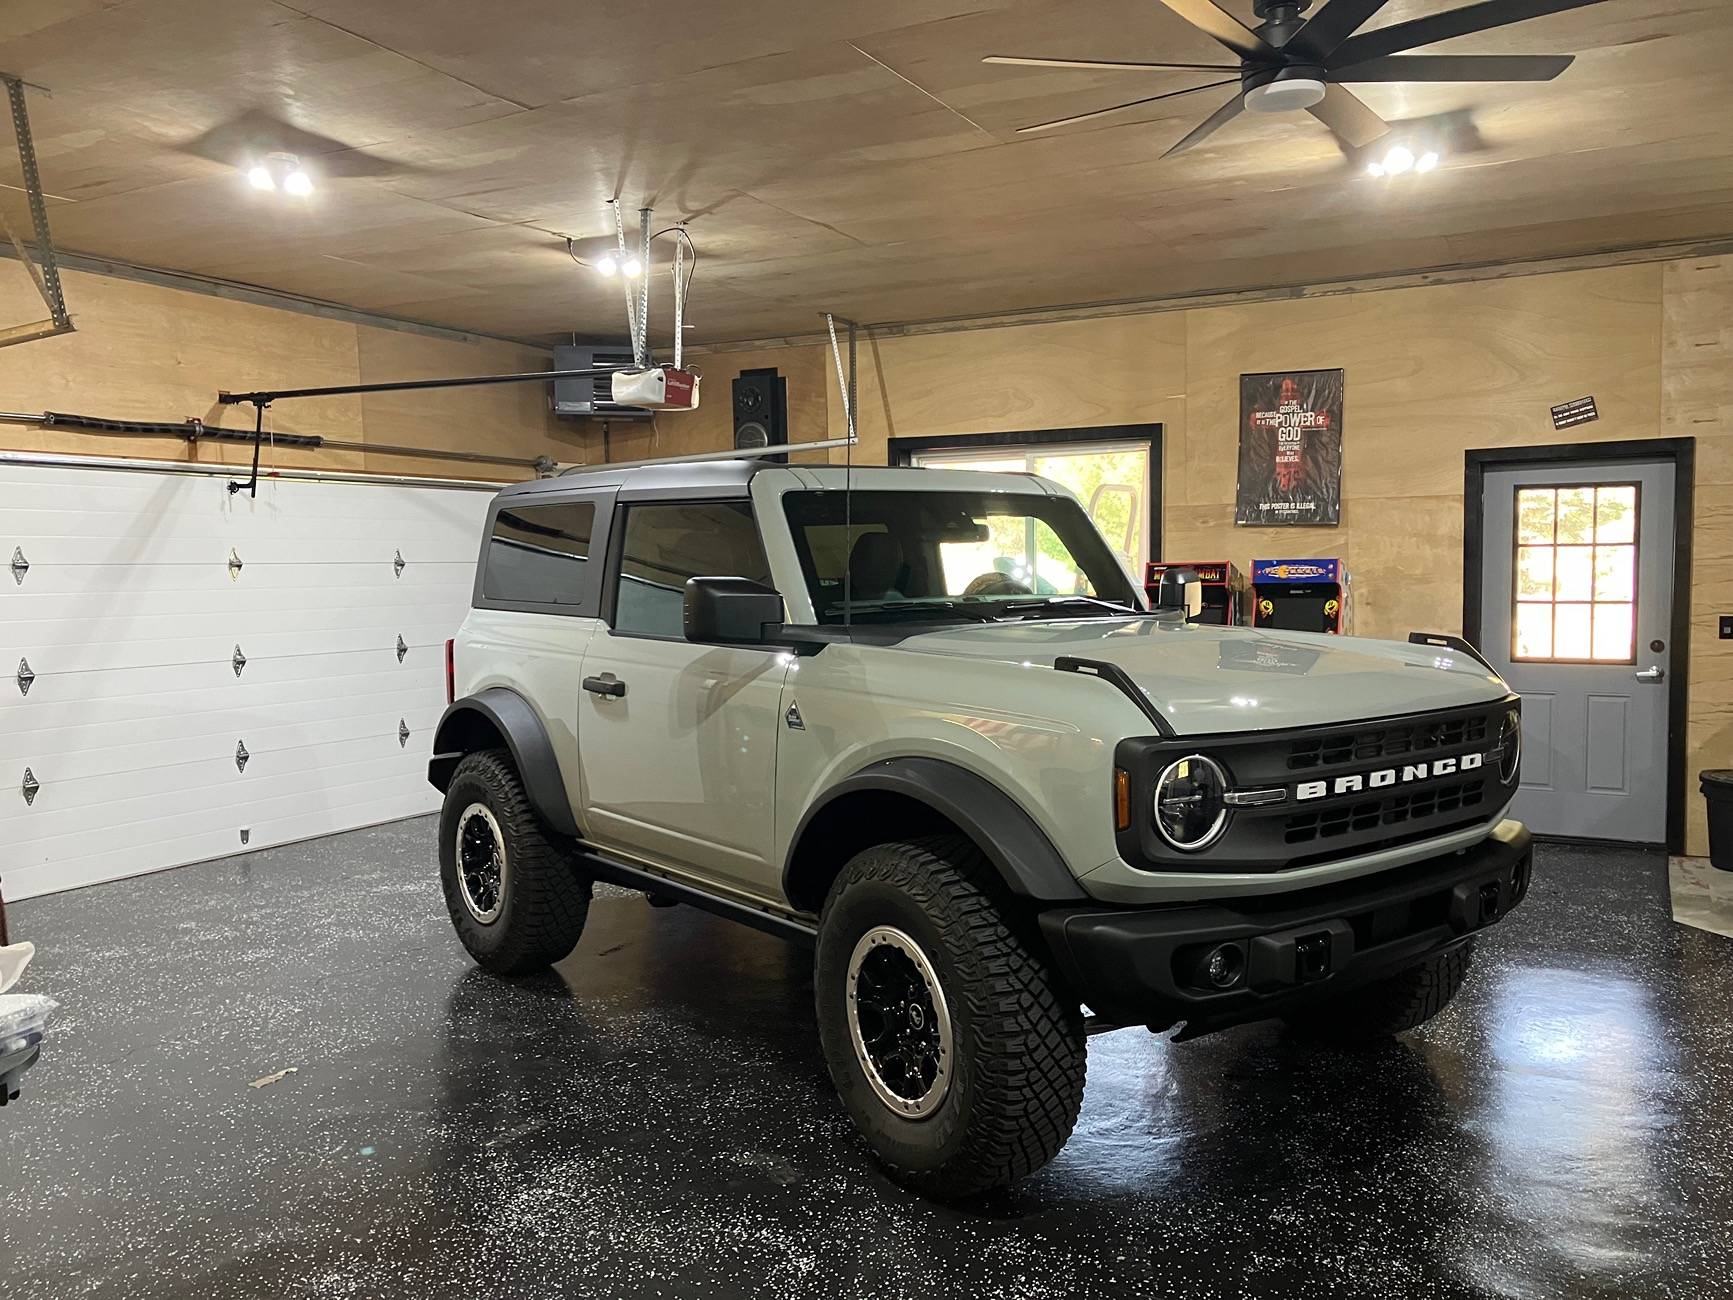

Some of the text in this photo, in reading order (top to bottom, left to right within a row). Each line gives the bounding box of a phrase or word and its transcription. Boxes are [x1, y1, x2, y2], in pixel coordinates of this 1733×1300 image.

[1276, 412, 1325, 427] POWER OF
[1278, 427, 1300, 441] GOD
[1271, 502, 1290, 510] POSTER
[1297, 753, 1482, 800] BRONCO
